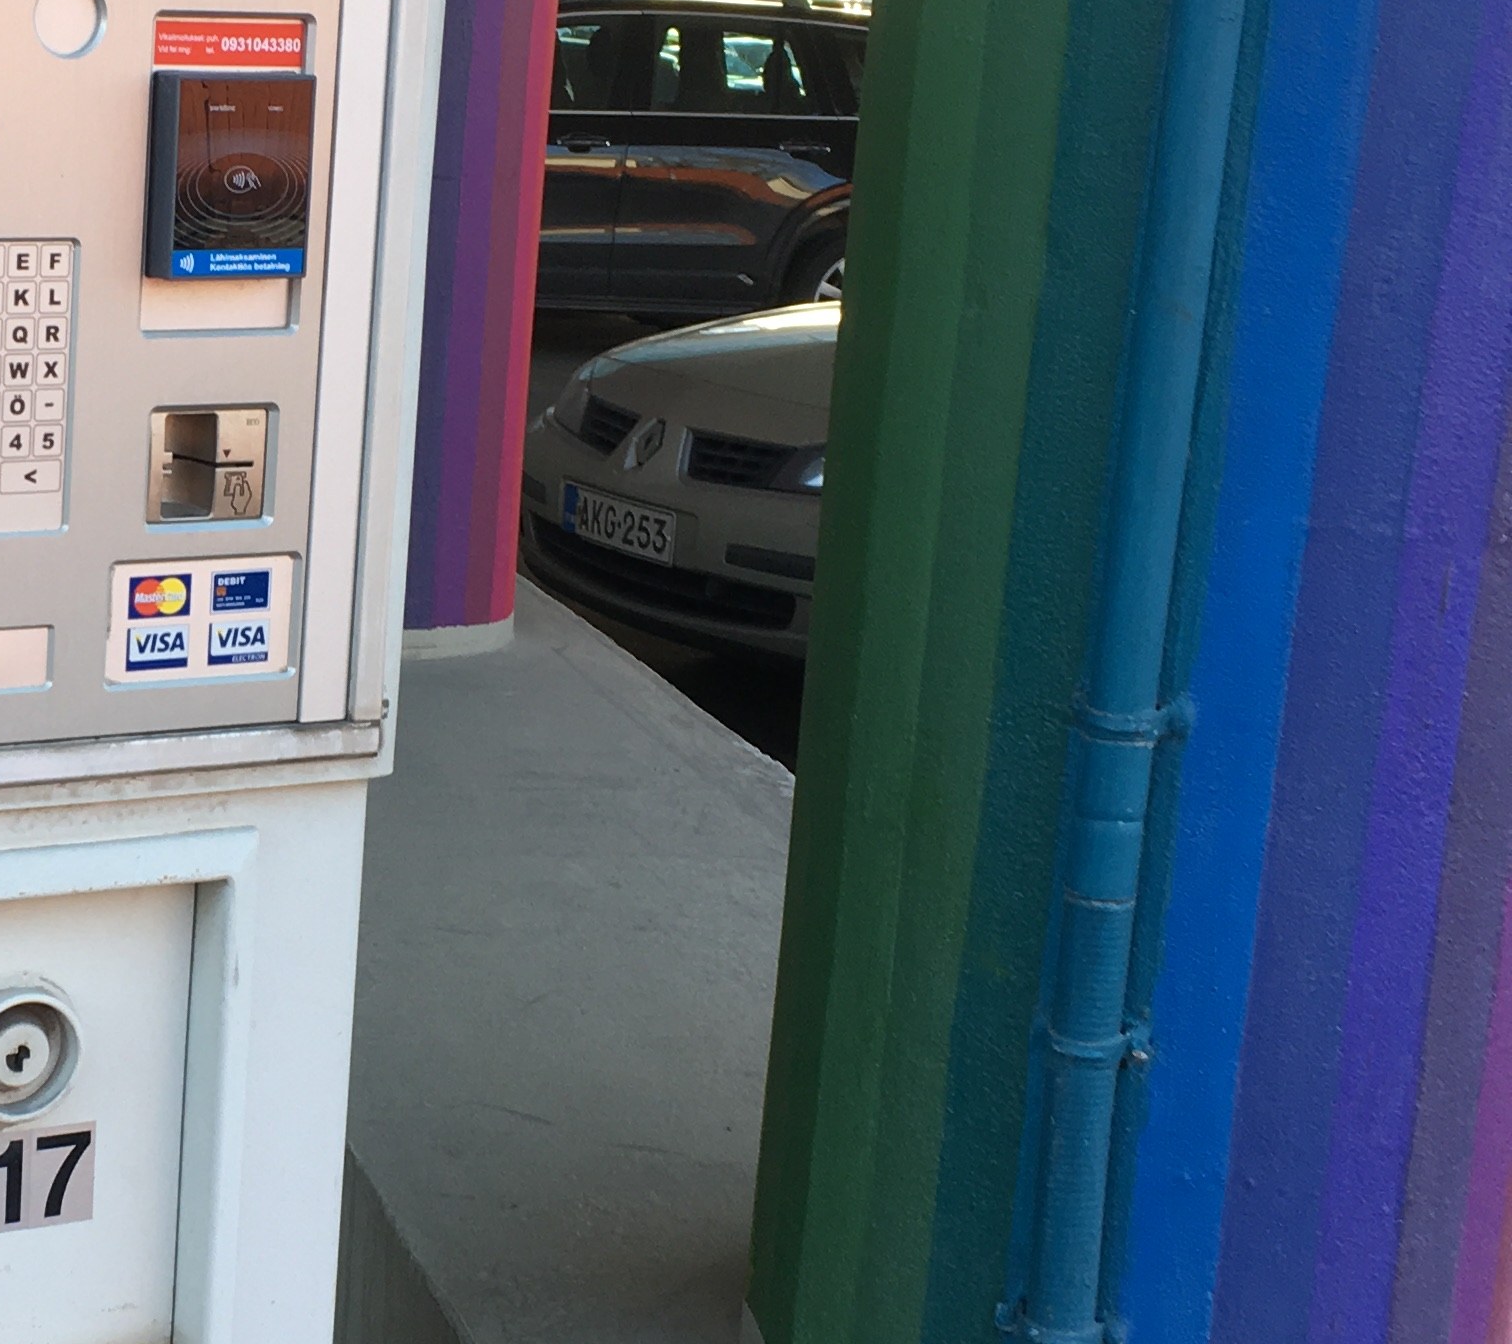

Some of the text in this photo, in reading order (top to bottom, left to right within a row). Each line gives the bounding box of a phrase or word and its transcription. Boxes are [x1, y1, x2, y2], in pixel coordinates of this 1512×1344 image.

[221, 37, 301, 53] 0931043380
[16, 253, 30, 270] E
[49, 253, 62, 270] F
[254, 262, 290, 272] betalning
[14, 289, 29, 306] K
[49, 289, 61, 305] L
[12, 326, 28, 344] Q
[46, 325, 59, 342] R
[9, 362, 29, 379] W
[43, 361, 58, 378] X
[10, 394, 25, 415] Ö
[9, 434, 22, 450] 4
[42, 433, 54, 450] 5
[578, 496, 668, 554] AKG-253
[218, 576, 246, 586] DEBIT
[136, 632, 185, 654] VISA
[218, 626, 265, 648] VISA
[232, 654, 266, 663] ELECTRON
